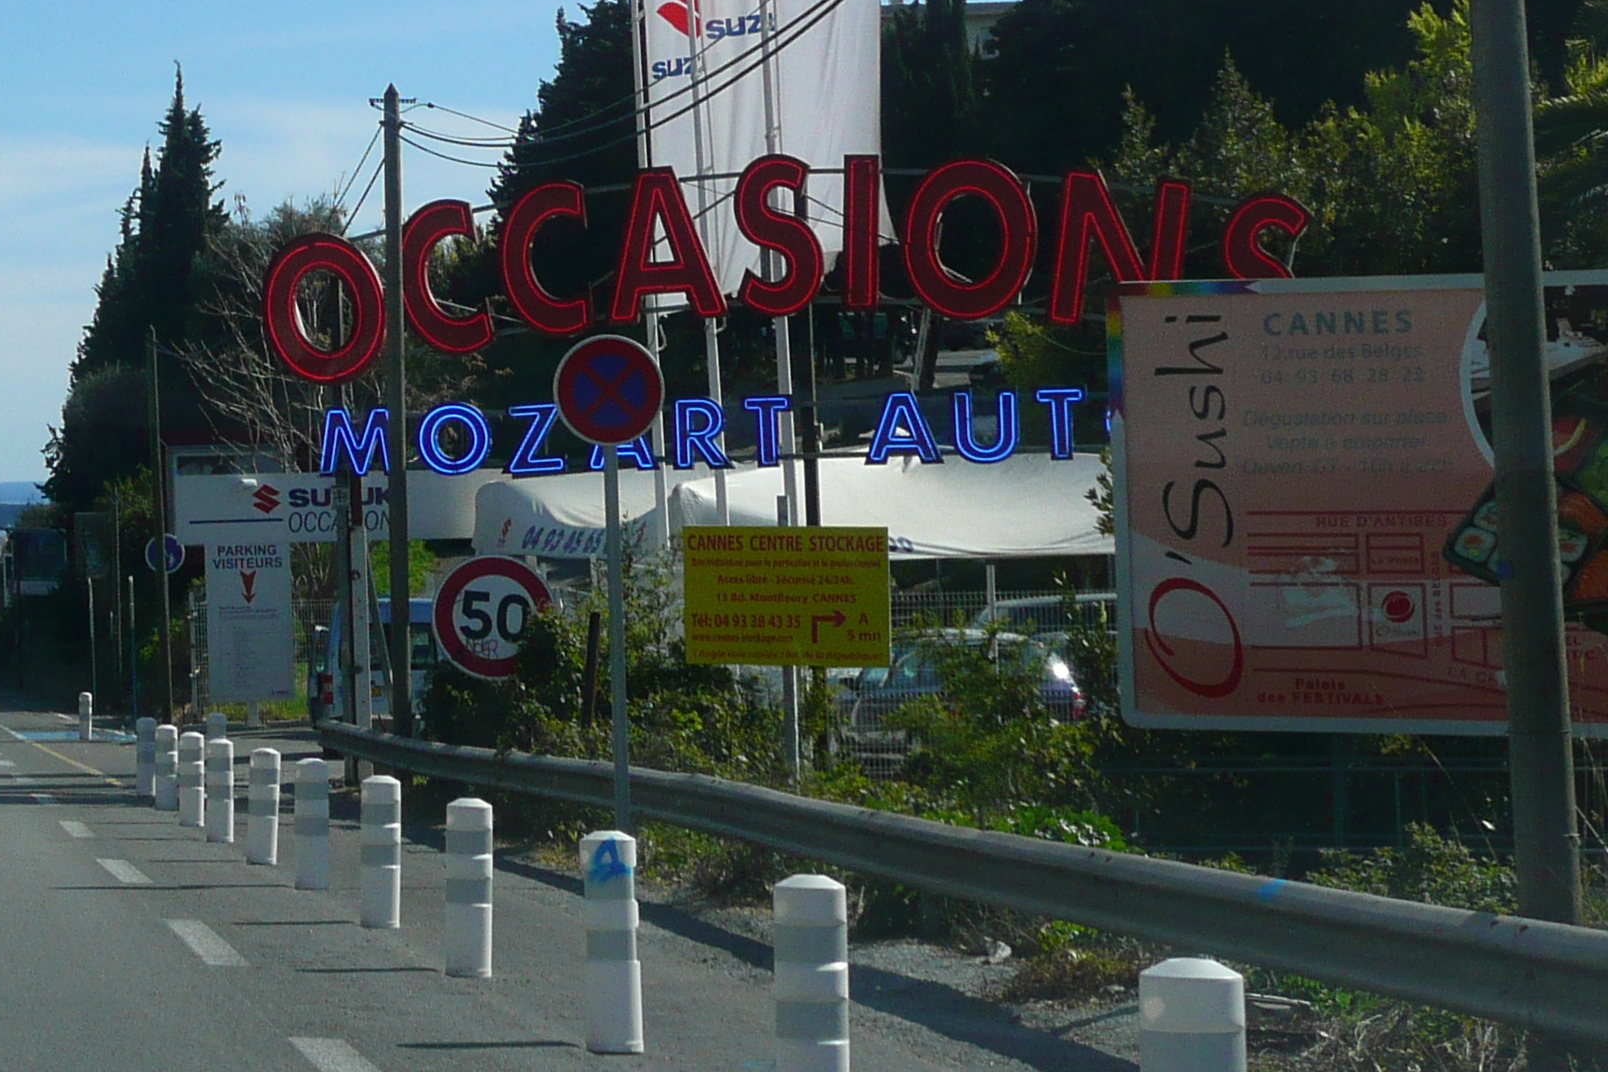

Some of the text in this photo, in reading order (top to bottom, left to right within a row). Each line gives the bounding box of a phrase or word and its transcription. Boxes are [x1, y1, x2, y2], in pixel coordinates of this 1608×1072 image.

[261, 153, 1313, 384] OCCASIONS
[1263, 309, 1413, 336] CANNES
[866, 387, 1112, 464] AUT
[1316, 516, 1350, 528] RUE
[217, 544, 278, 557] PARKING
[687, 534, 885, 553] CANNES CENTRE STOCKAGE
[213, 556, 283, 570] VISITEURS
[812, 594, 857, 604] CANNES
[459, 590, 532, 643] 50
[714, 614, 729, 628] 04
[732, 614, 747, 628] 93
[750, 615, 764, 629] 38
[768, 615, 783, 629] 43
[787, 615, 802, 629] 35
[858, 612, 869, 625] A
[847, 628, 856, 642] 5
[1291, 692, 1385, 706] FESTIVALS
